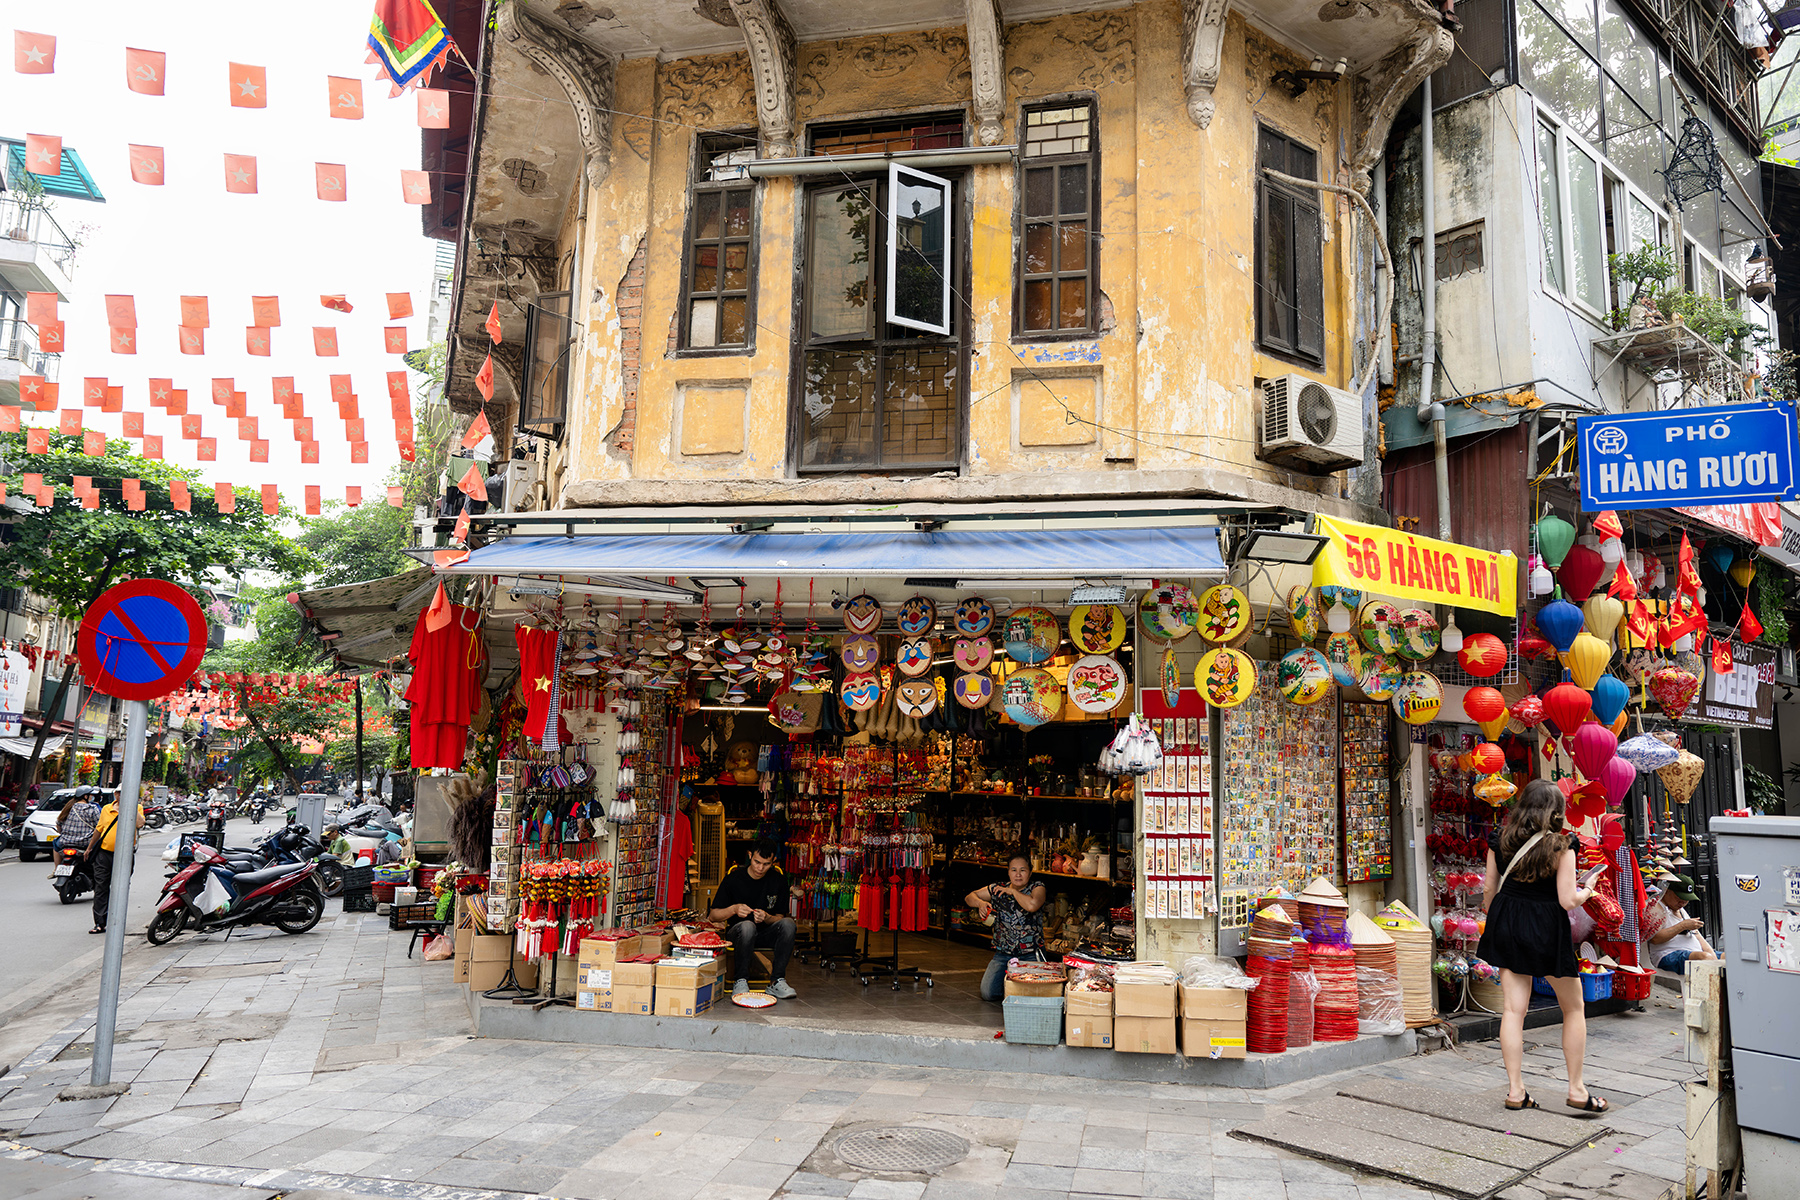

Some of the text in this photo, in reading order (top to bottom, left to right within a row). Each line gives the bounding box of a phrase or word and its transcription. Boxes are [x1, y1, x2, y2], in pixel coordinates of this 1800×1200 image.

[1665, 415, 1733, 443] PHỐ
[1599, 451, 1779, 494] HÀNG RƯƠI
[1344, 533, 1500, 604] 56 HÀNG MÃ
[1715, 661, 1759, 709] BEER
